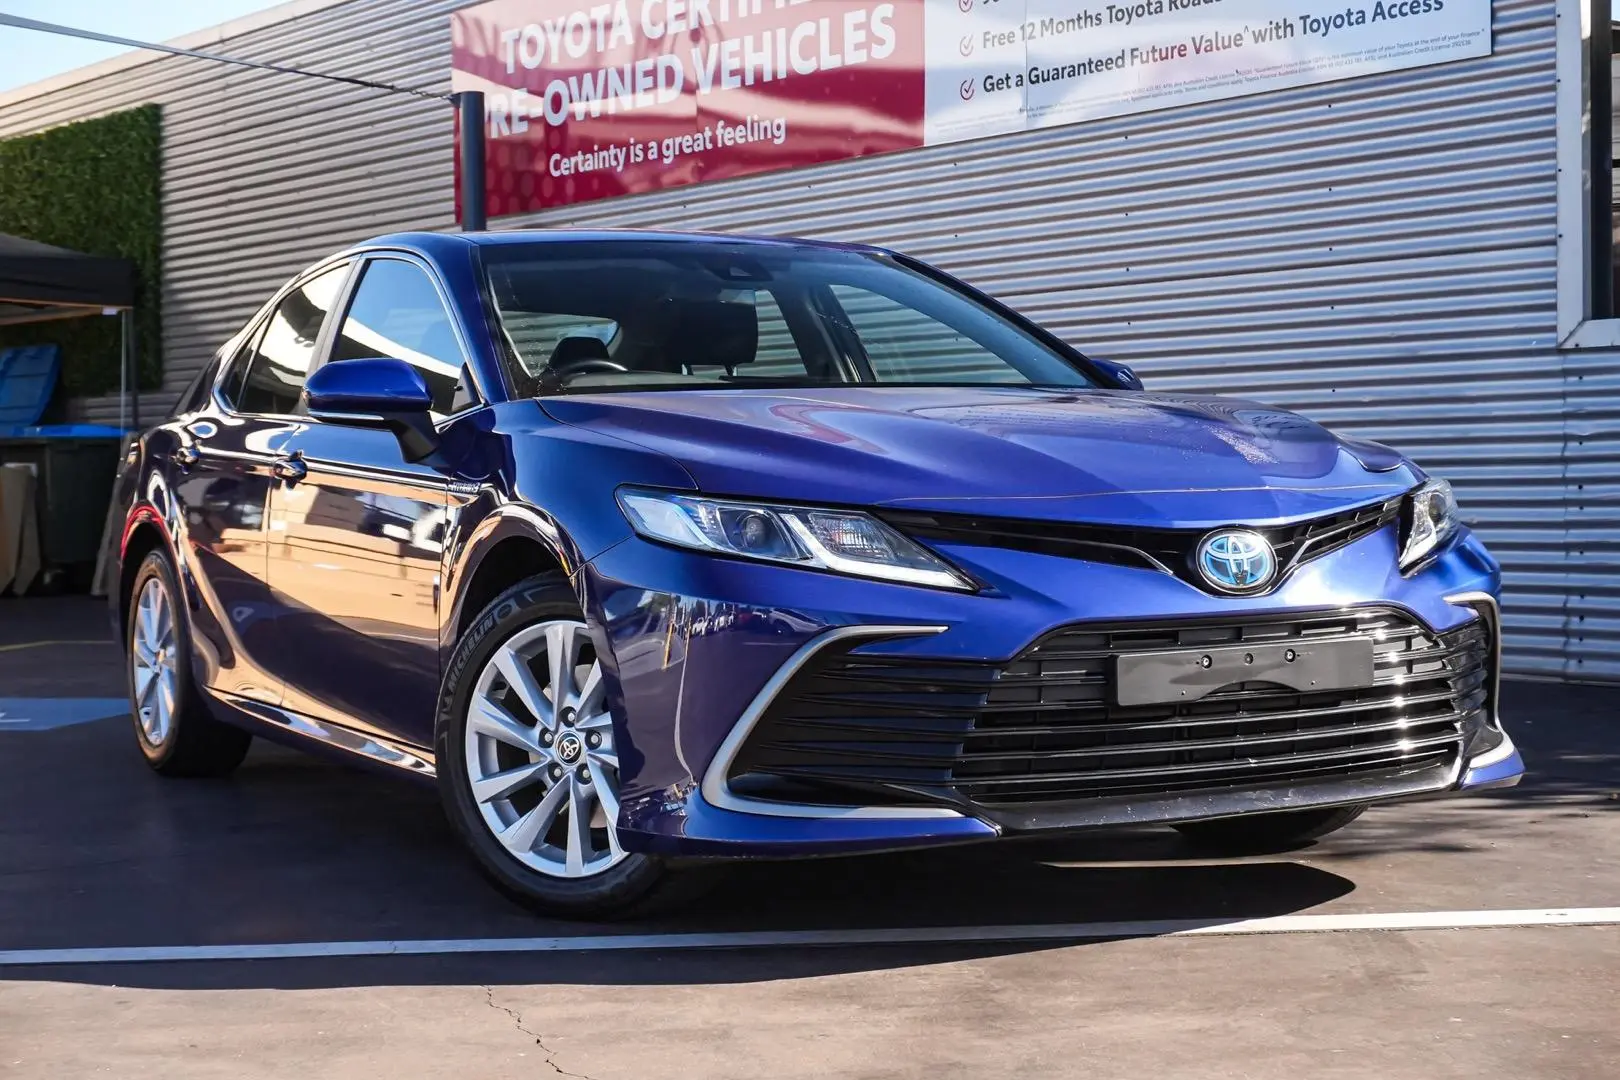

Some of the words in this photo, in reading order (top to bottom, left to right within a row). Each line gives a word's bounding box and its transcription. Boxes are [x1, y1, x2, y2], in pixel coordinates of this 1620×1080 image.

[501, 0, 634, 74] TOYOTA
[983, 30, 1016, 49] Free
[1020, 22, 1037, 41] 12
[1040, 9, 1102, 38] Months
[1106, 0, 1164, 26] Toyota
[983, 72, 1012, 93] Get
[1015, 73, 1025, 88] a
[1028, 49, 1126, 86] Guaranteed
[1130, 43, 1188, 68] Future
[1252, 17, 1295, 44] with
[1299, 7, 1366, 38] Toyota
[1372, 0, 1445, 22] Access
[484, 54, 683, 138] RE-OWNED
[691, 3, 897, 95] VEHICLES
[549, 144, 626, 178] Certainty
[630, 138, 645, 164] is
[648, 139, 658, 161] a
[662, 130, 713, 164] great
[716, 115, 787, 146] feeling
